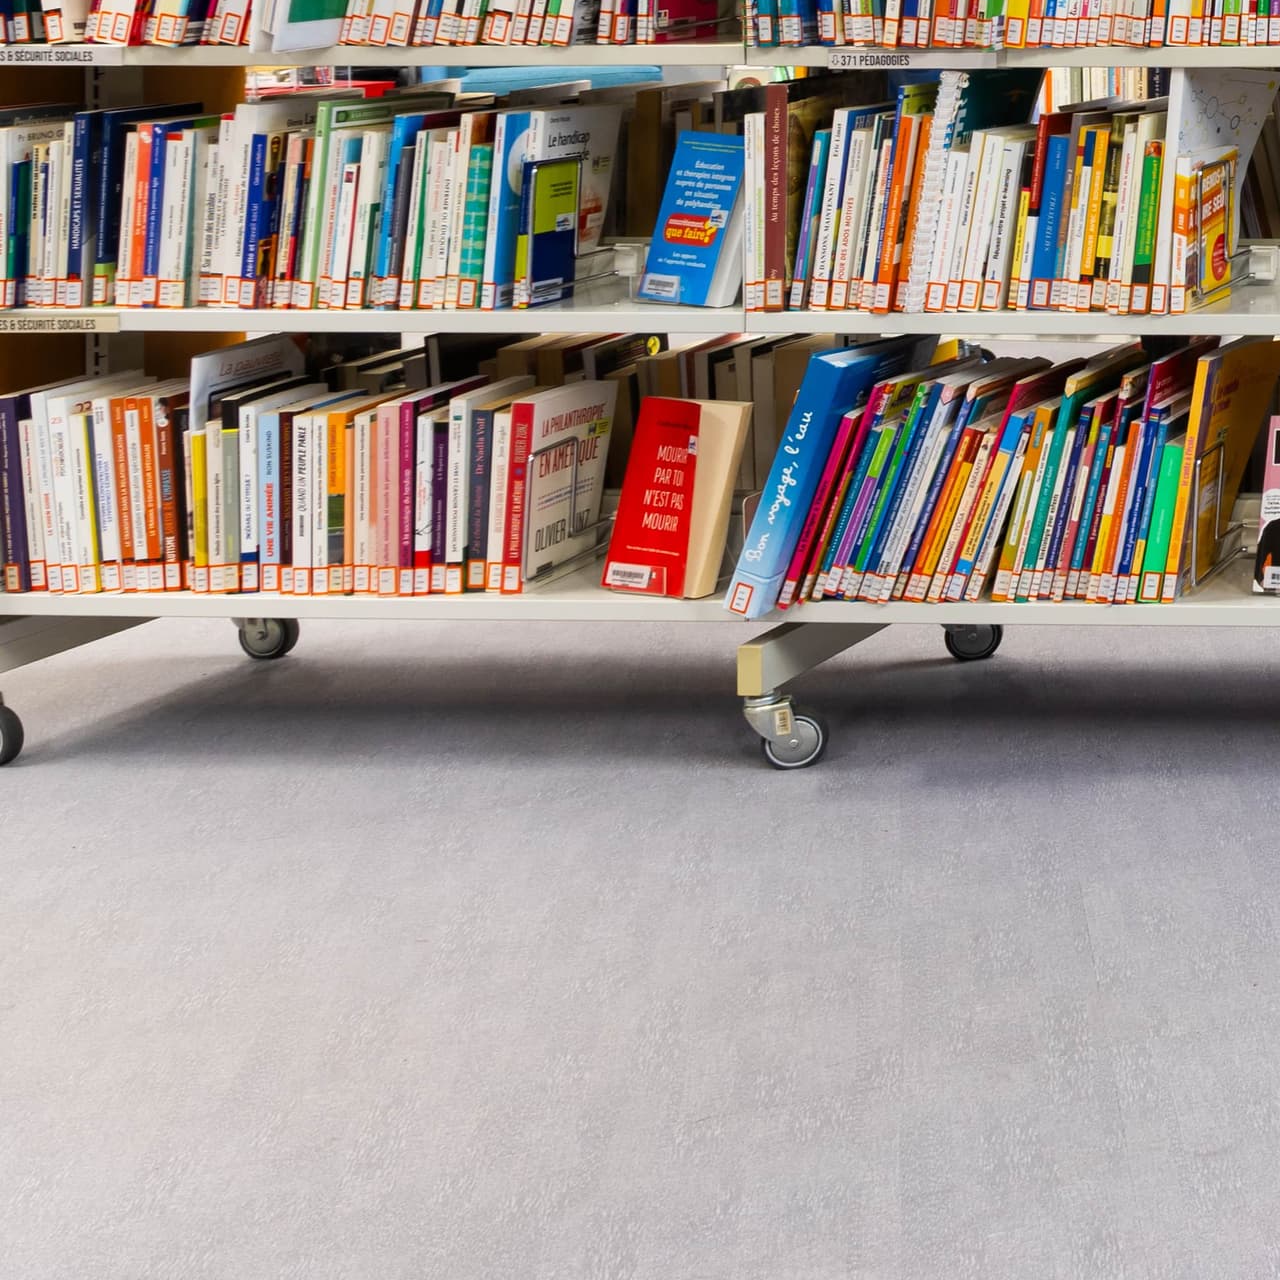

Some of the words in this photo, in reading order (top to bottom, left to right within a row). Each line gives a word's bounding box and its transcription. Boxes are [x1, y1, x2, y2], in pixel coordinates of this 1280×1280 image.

[840, 55, 857, 66] 371
[859, 52, 910, 66] PÉDAGOGIES
[655, 445, 689, 464] MOURIR
[654, 467, 672, 487] PAR
[672, 467, 685, 487] TOI
[744, 531, 770, 563] Bon
[783, 409, 814, 456] l'eau
[643, 489, 669, 509] N'EST
[671, 492, 685, 511] PAS
[641, 511, 680, 533] MOURIR
